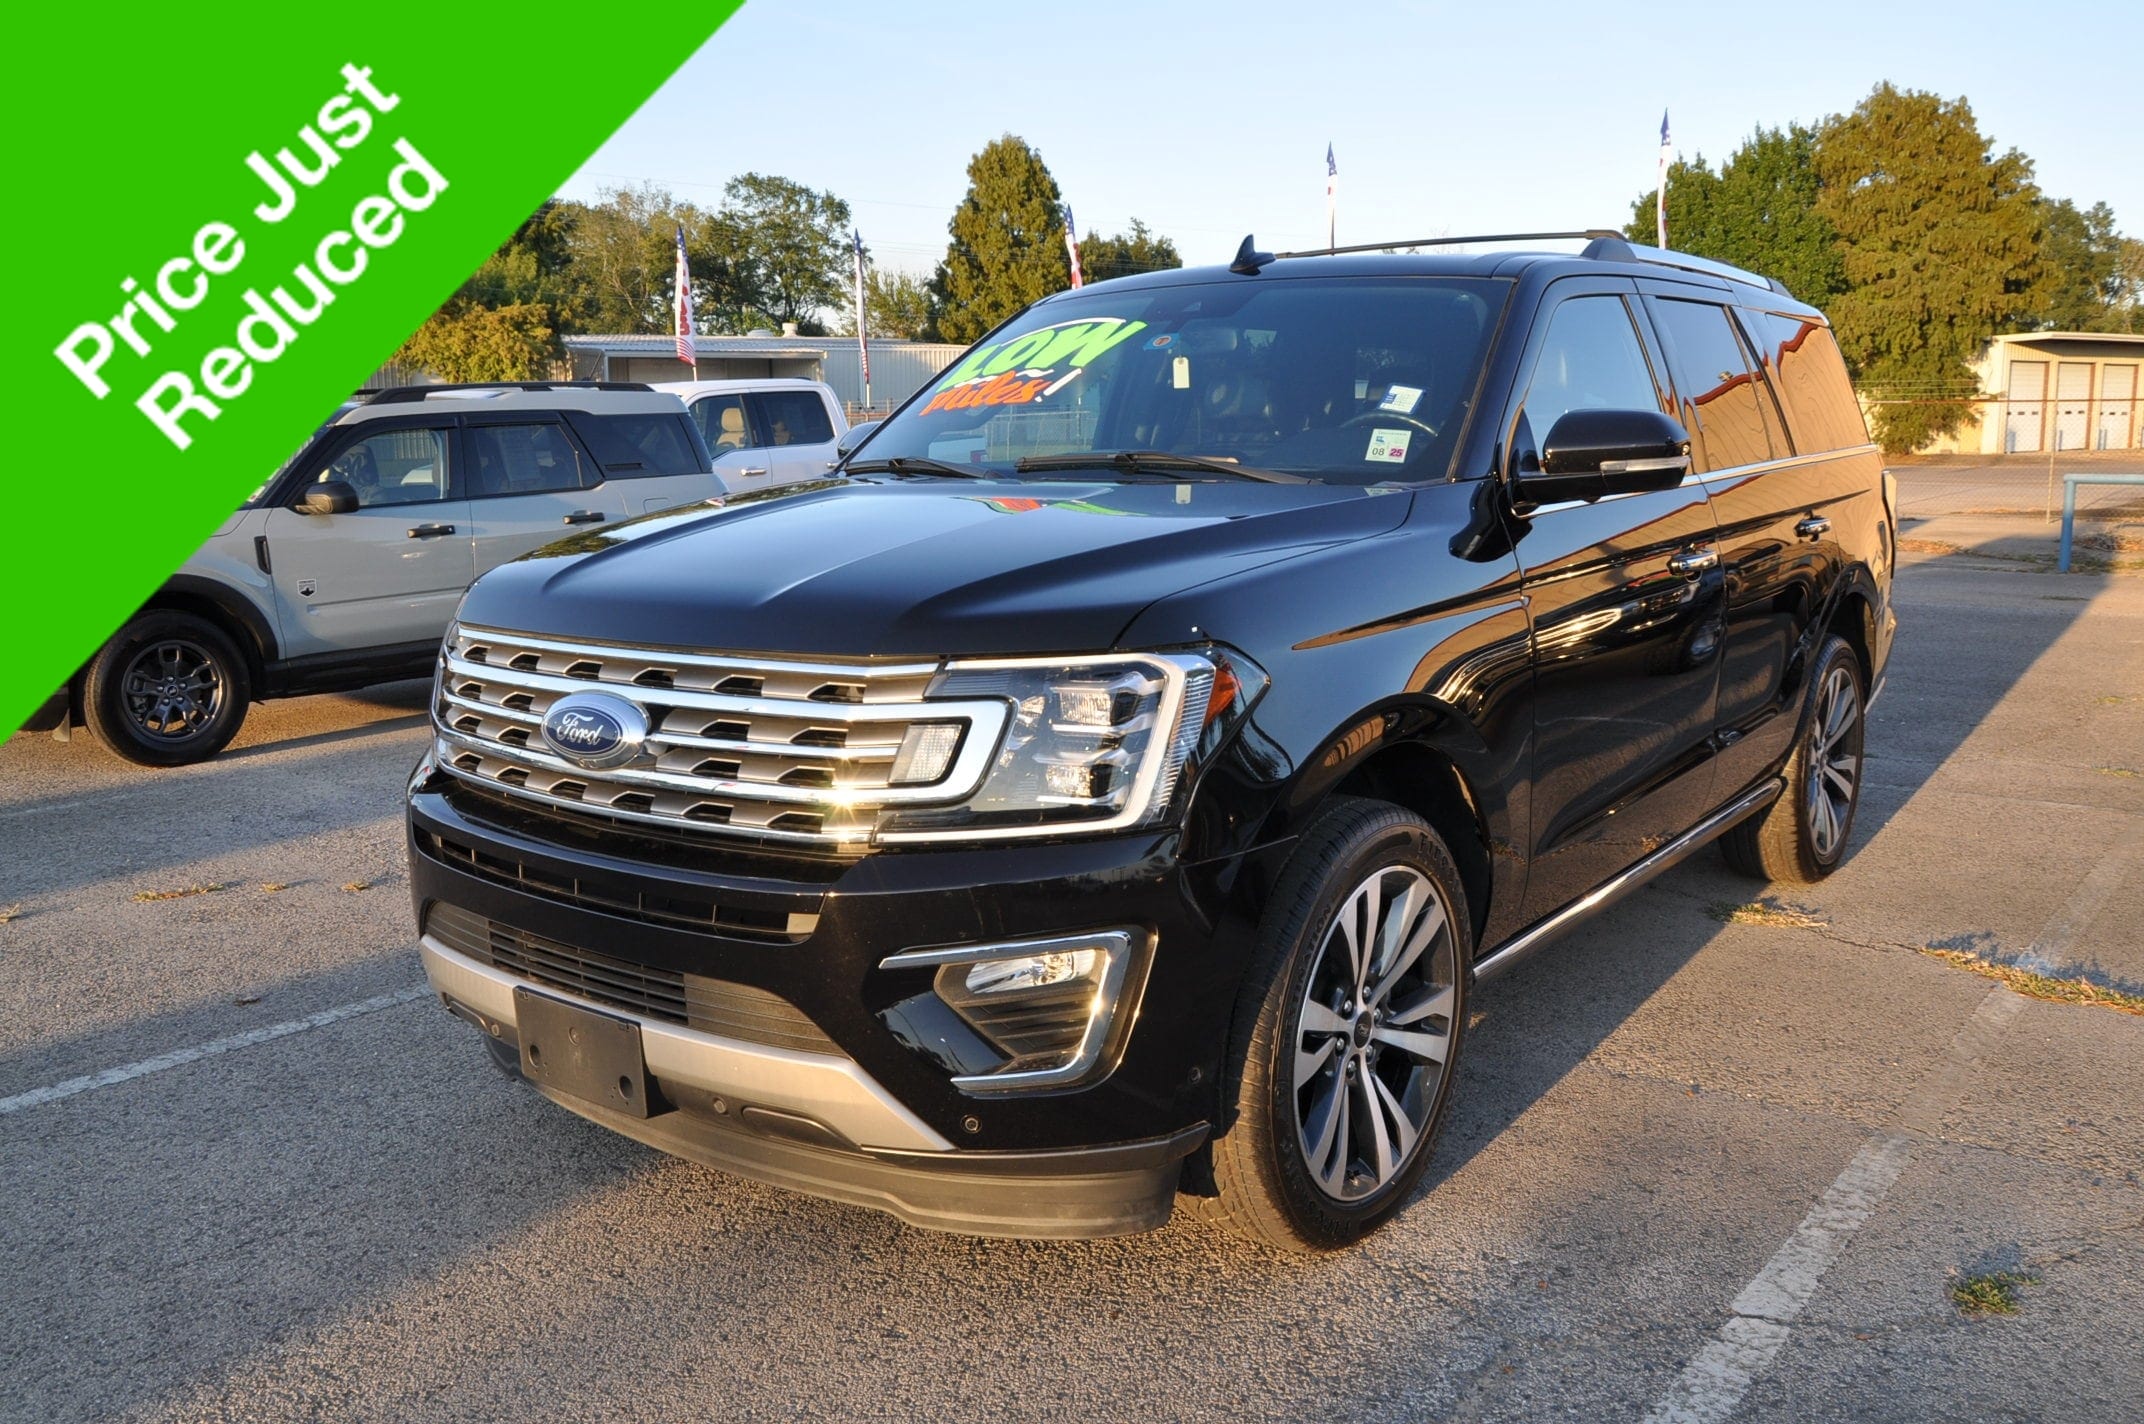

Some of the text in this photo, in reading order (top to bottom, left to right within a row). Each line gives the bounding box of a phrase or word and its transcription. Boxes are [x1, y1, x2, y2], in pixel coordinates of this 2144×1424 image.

[936, 320, 1148, 393] LOW
[1372, 447, 1404, 457] 08 25
[556, 712, 604, 744] Ford
